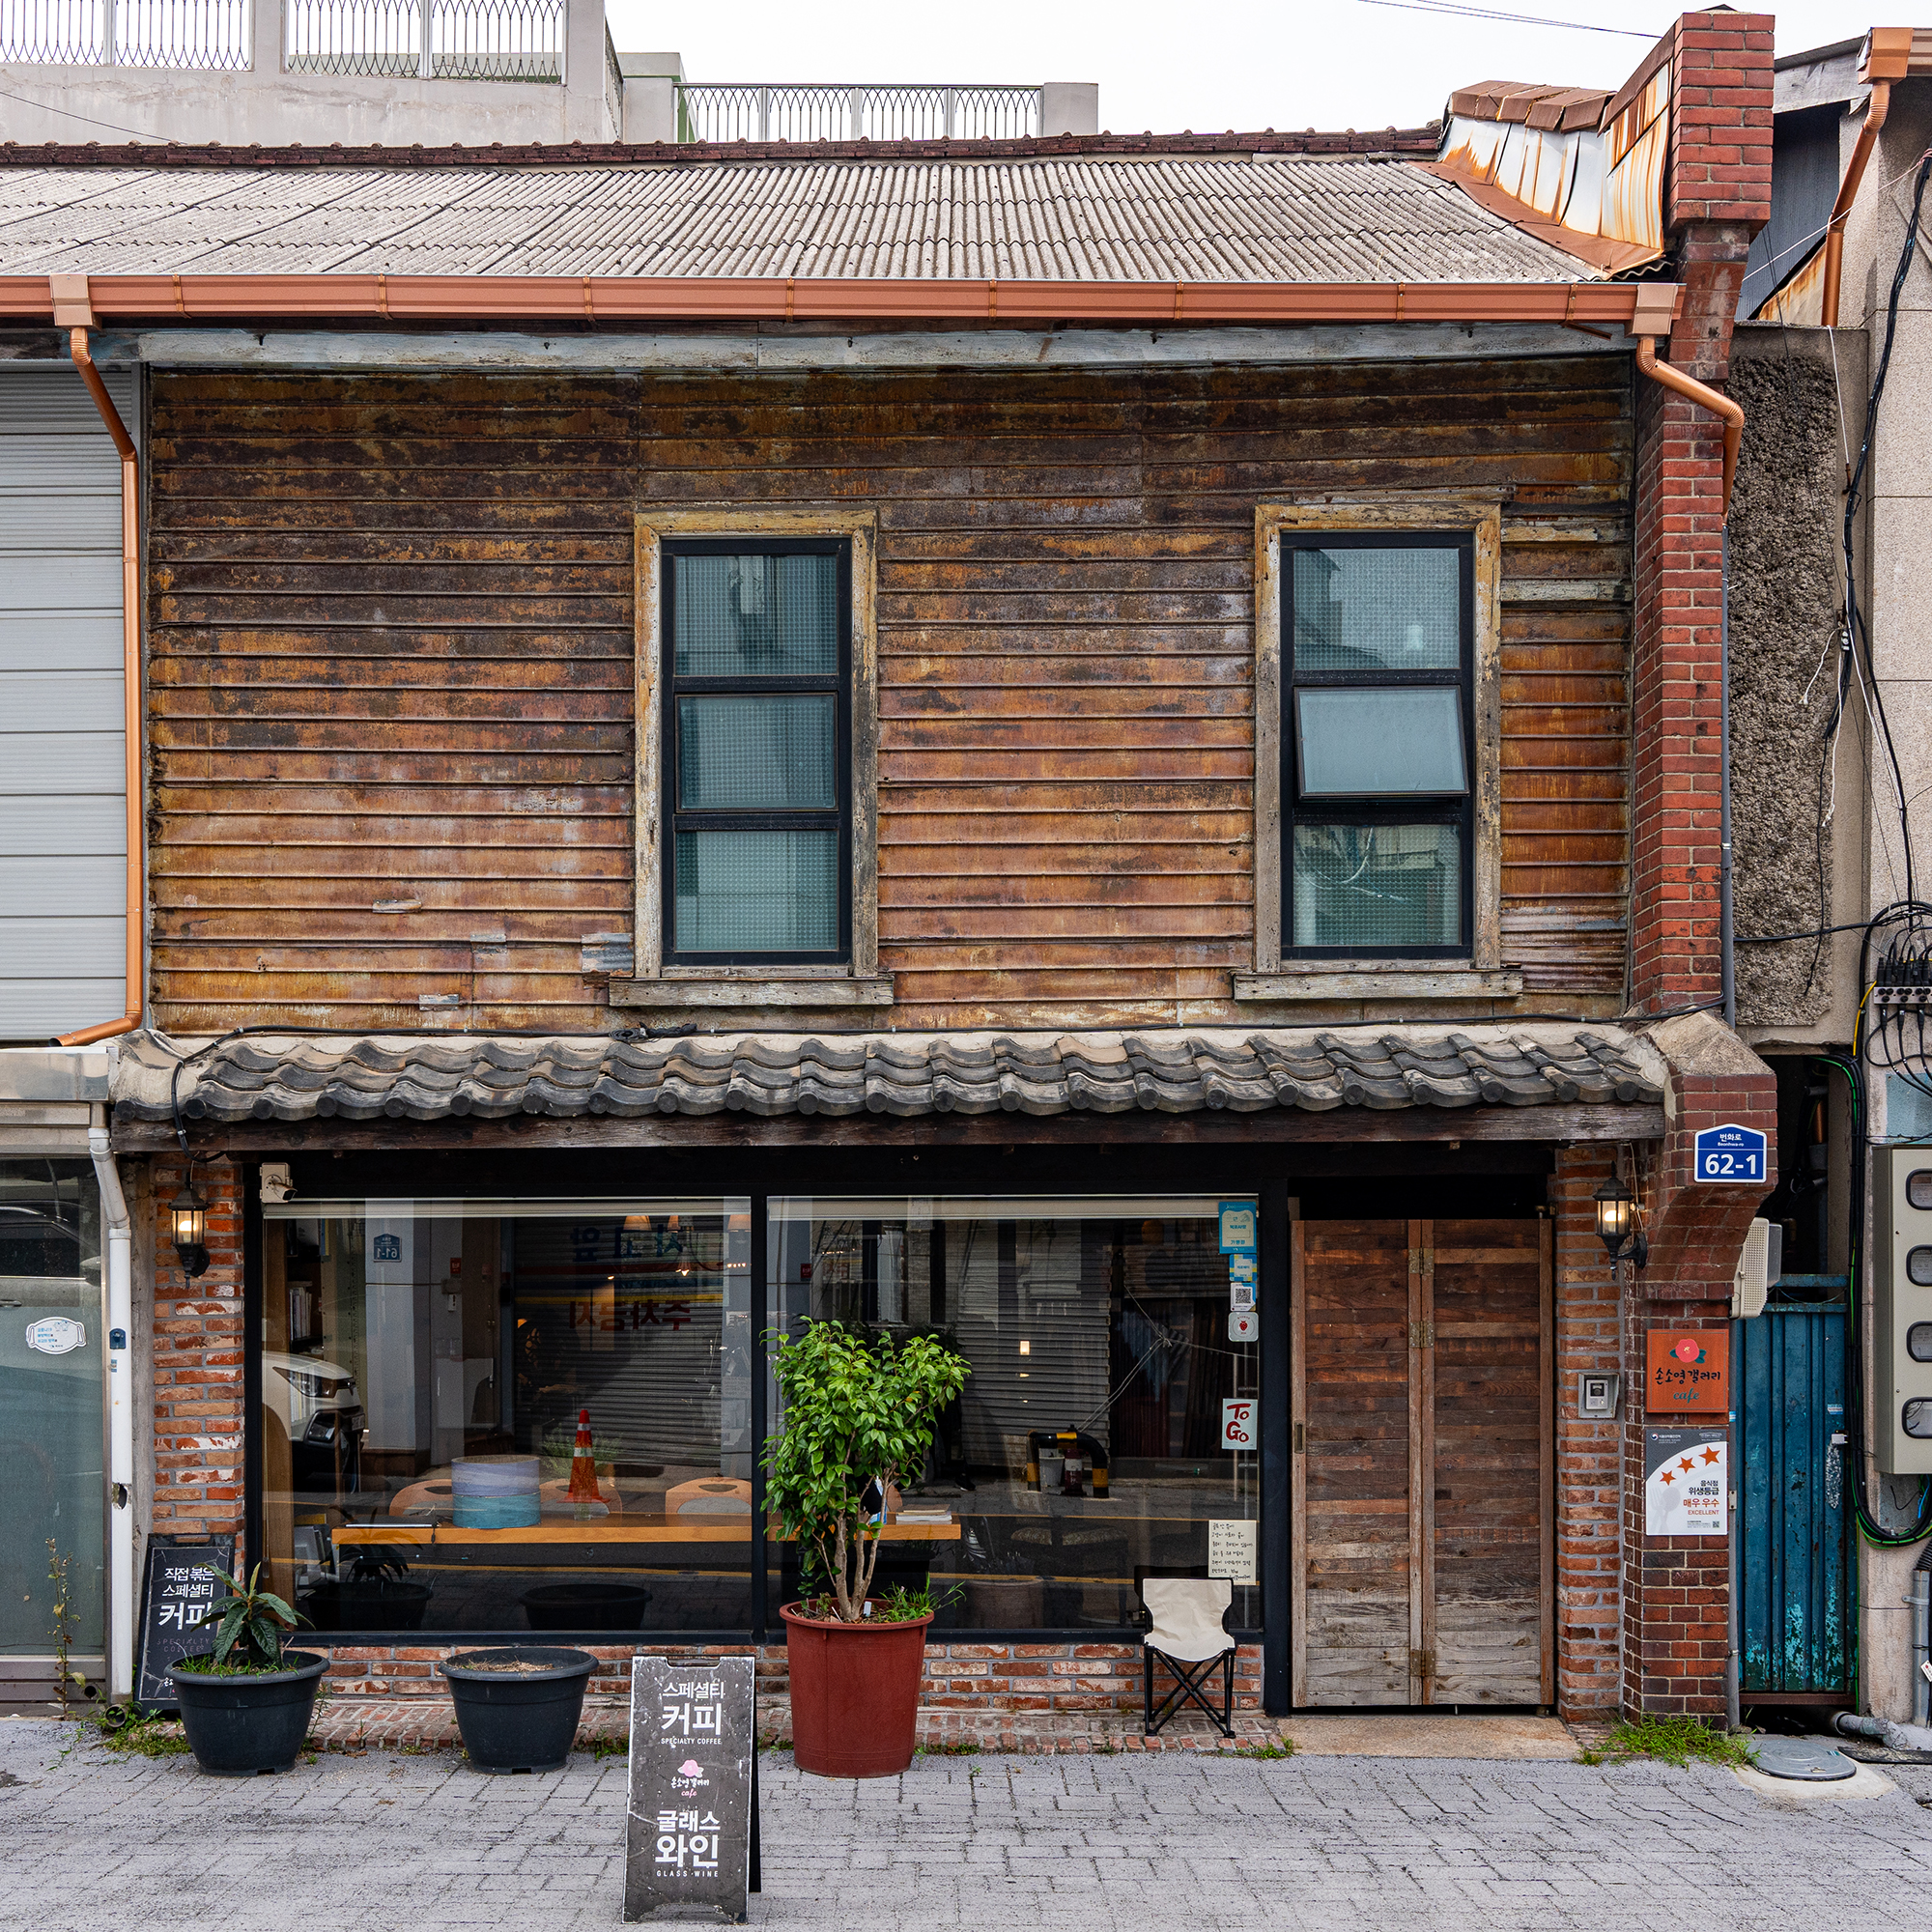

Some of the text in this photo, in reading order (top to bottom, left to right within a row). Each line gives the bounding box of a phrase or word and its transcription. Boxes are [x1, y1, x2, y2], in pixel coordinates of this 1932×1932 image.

[1719, 1133, 1742, 1142] 번화로
[1705, 1153, 1756, 1175] 62-1
[1673, 1387, 1700, 1404] cafe
[1226, 1403, 1252, 1420] To
[1226, 1420, 1250, 1443] Go
[1689, 1487, 1719, 1495] 위생등급
[1683, 1498, 1719, 1508] 매우 우수
[164, 1567, 215, 1581] 직접 볶은
[161, 1583, 213, 1598] 스페셜티
[157, 1602, 213, 1630] 커피
[663, 1682, 724, 1699] 스페셜티
[661, 1703, 722, 1736] 커피
[681, 1788, 697, 1798] cafe
[655, 1834, 719, 1867] 와인
